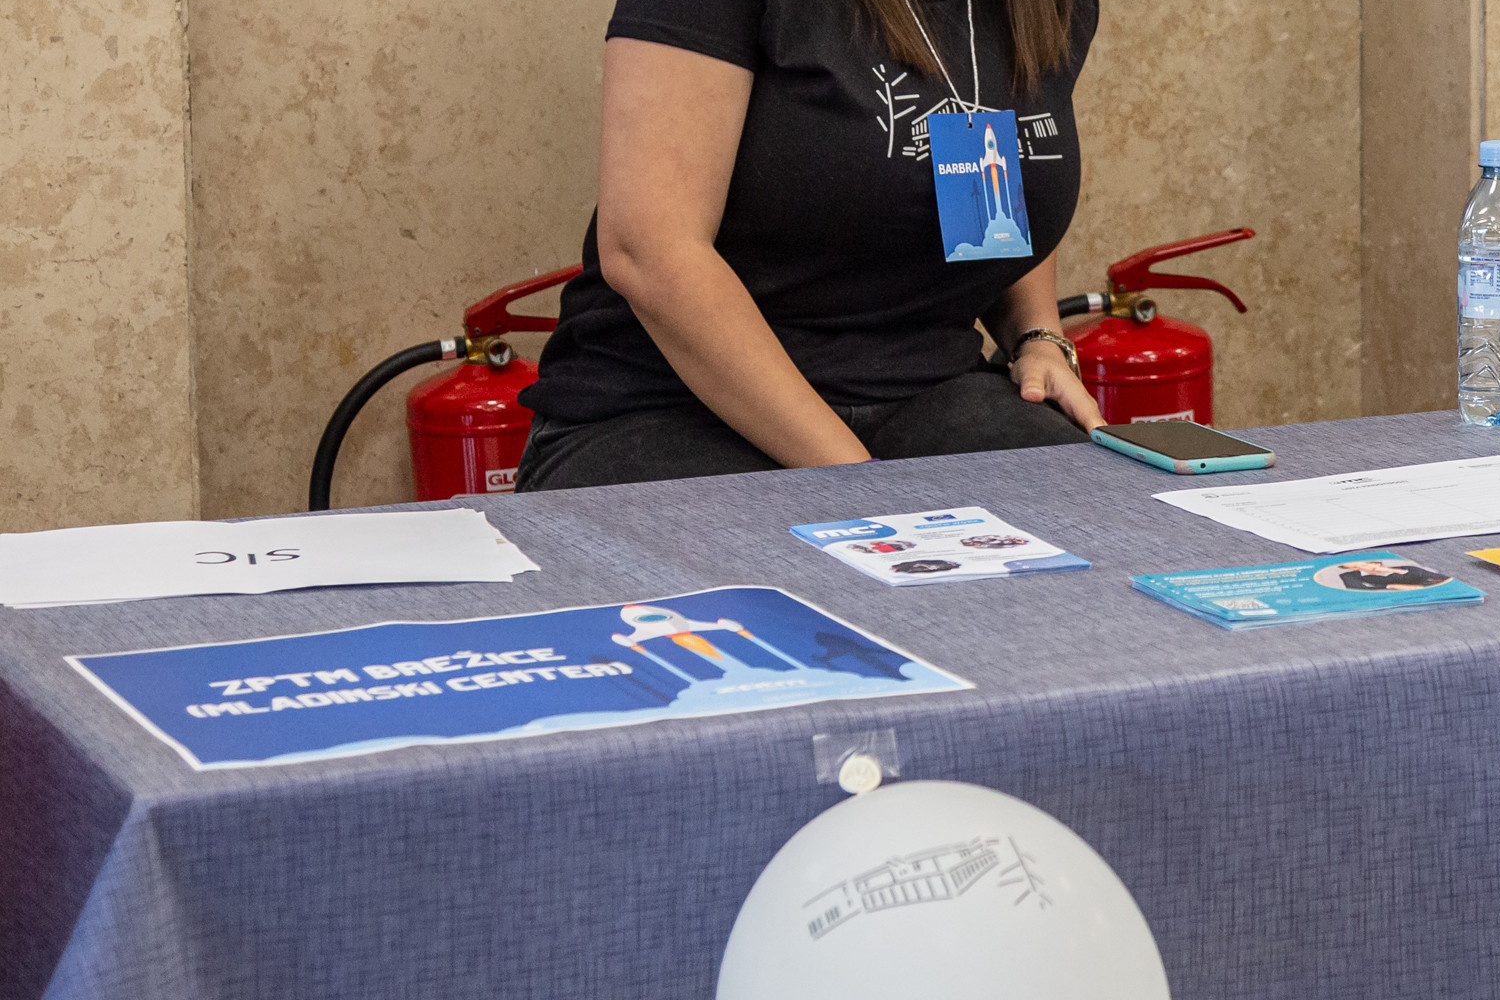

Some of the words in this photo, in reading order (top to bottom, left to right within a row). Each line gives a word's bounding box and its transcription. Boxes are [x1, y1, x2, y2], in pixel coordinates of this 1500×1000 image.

[938, 162, 980, 176] BARBRA
[195, 547, 301, 566] SIC
[209, 667, 356, 697] ZPTM
[361, 647, 567, 683] BREŽICE
[186, 678, 443, 719] (MLADINSKI
[445, 661, 634, 693] CENTER)
